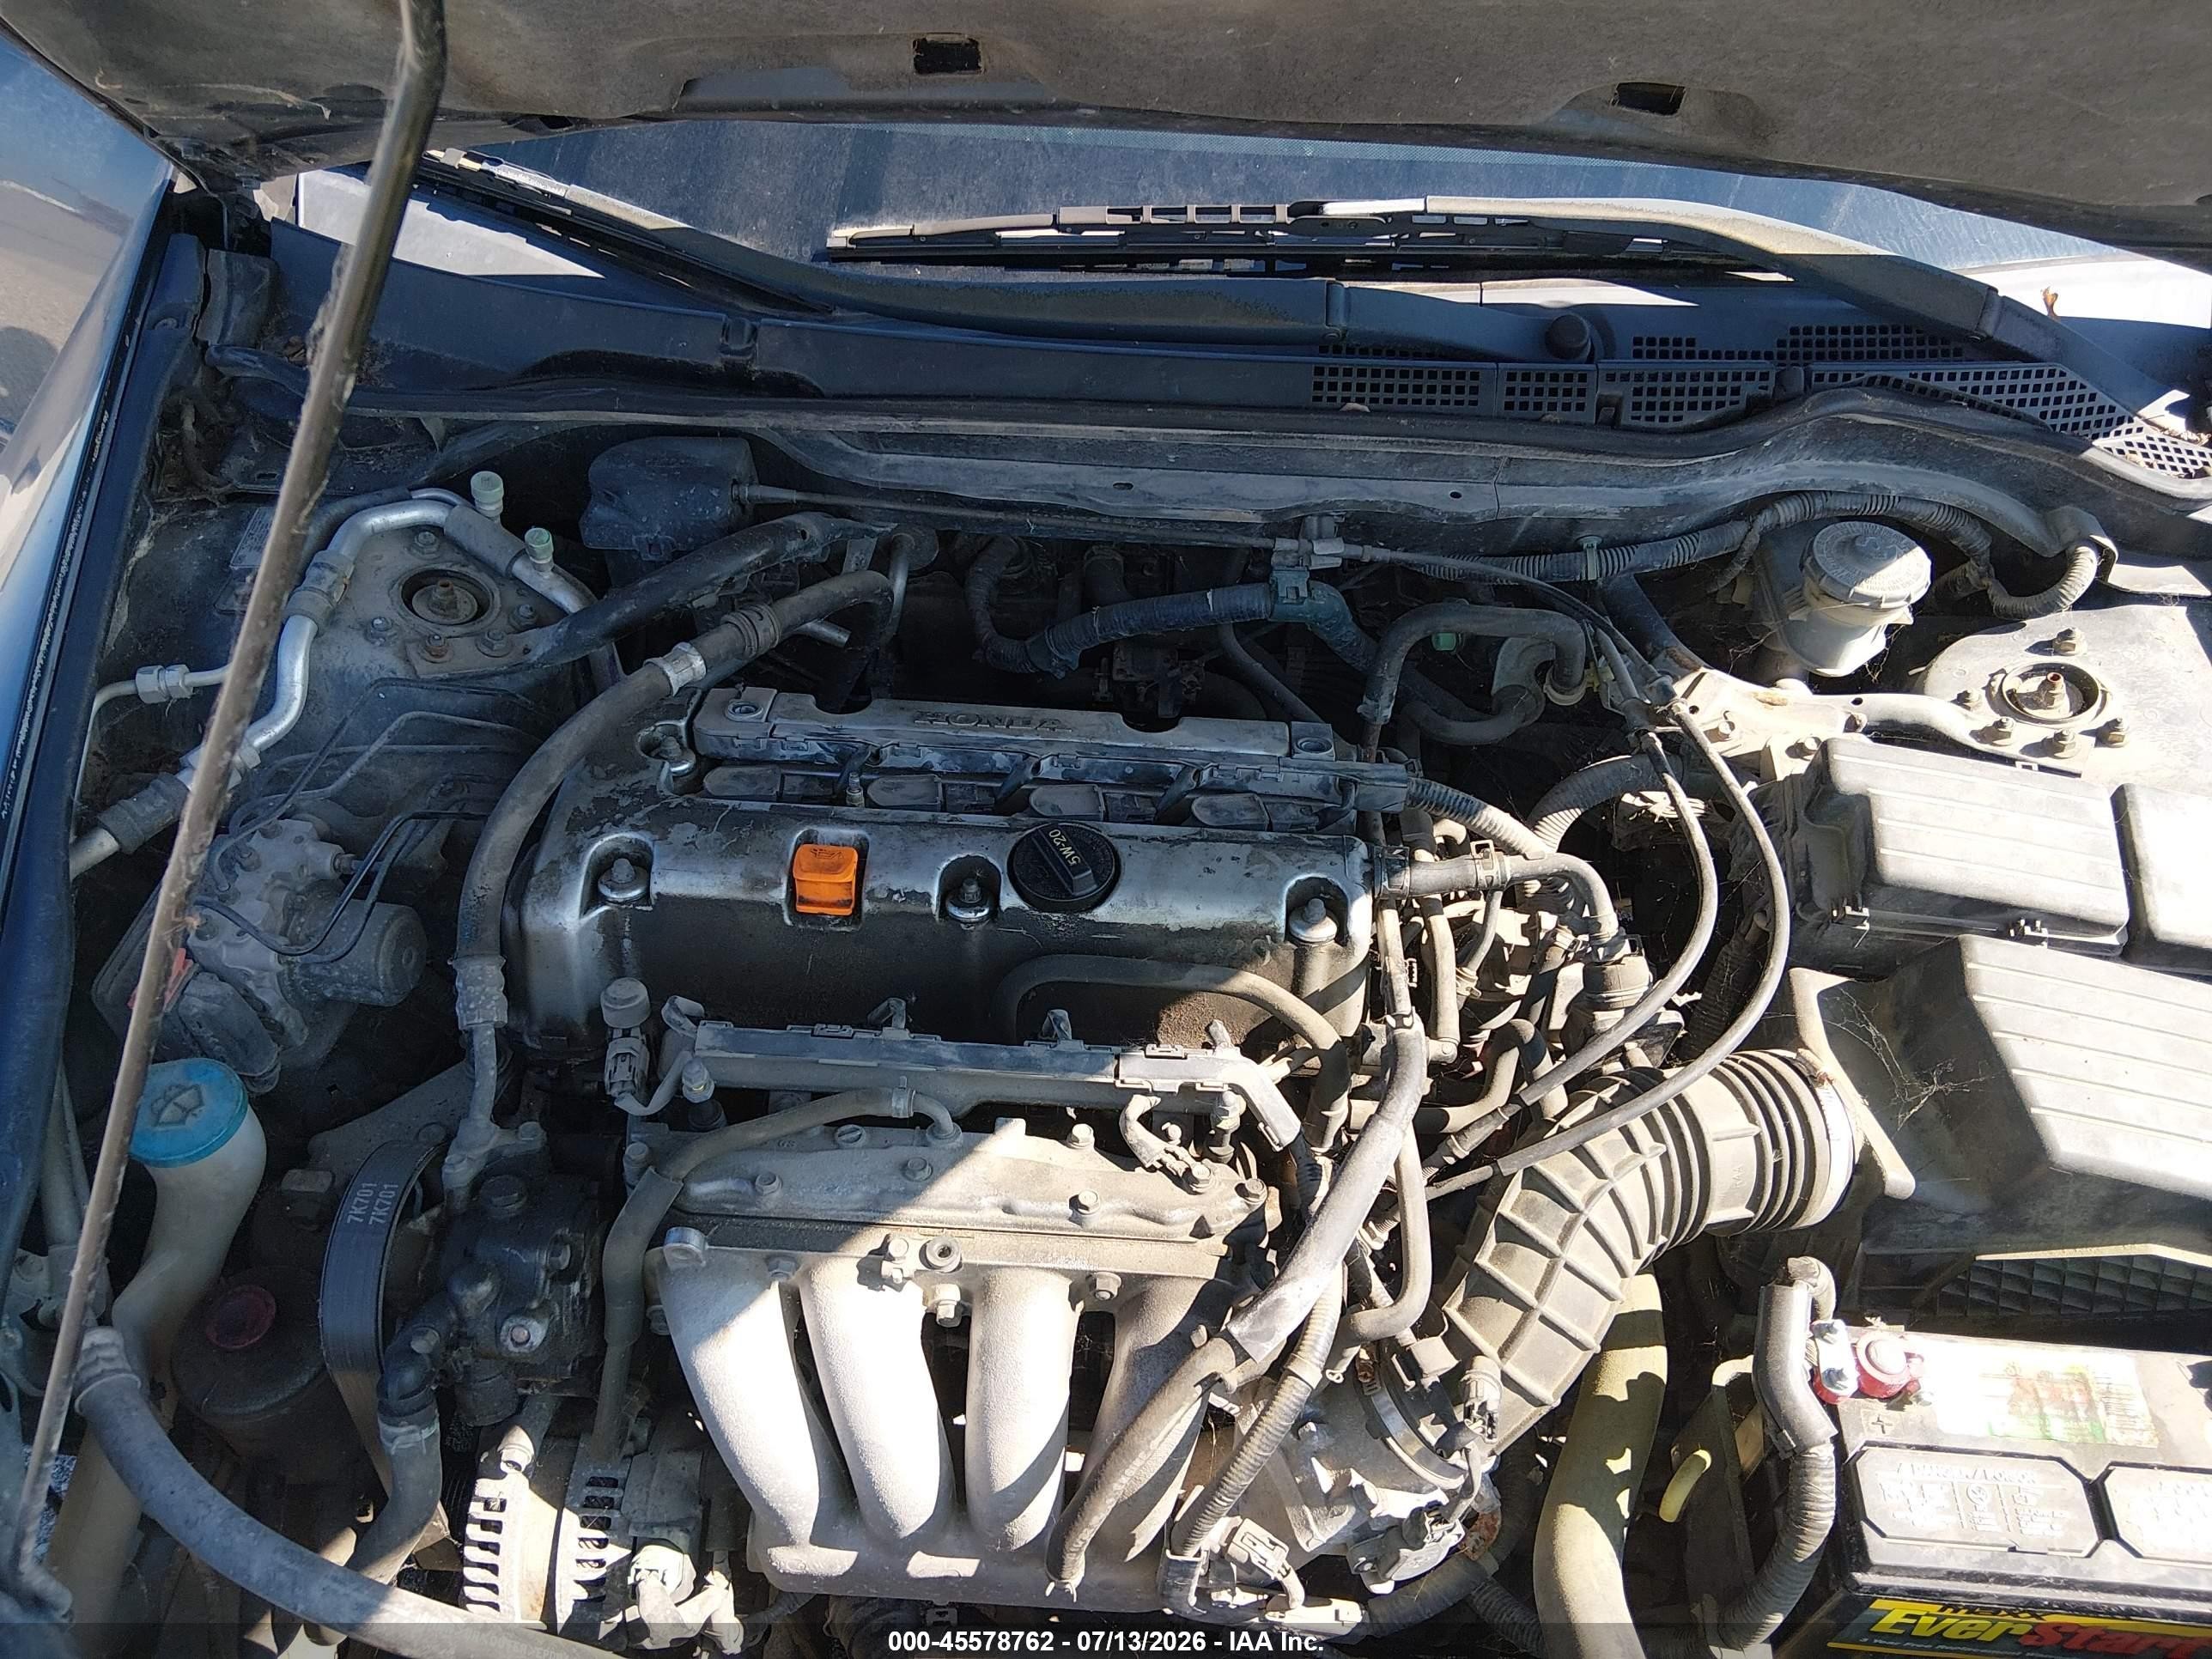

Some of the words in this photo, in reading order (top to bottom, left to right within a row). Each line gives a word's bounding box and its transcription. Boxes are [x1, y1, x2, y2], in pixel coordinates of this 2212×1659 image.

[1048, 829, 1082, 866] 5W-20
[348, 1182, 378, 1224] 7K701
[370, 1184, 398, 1224] 7K701
